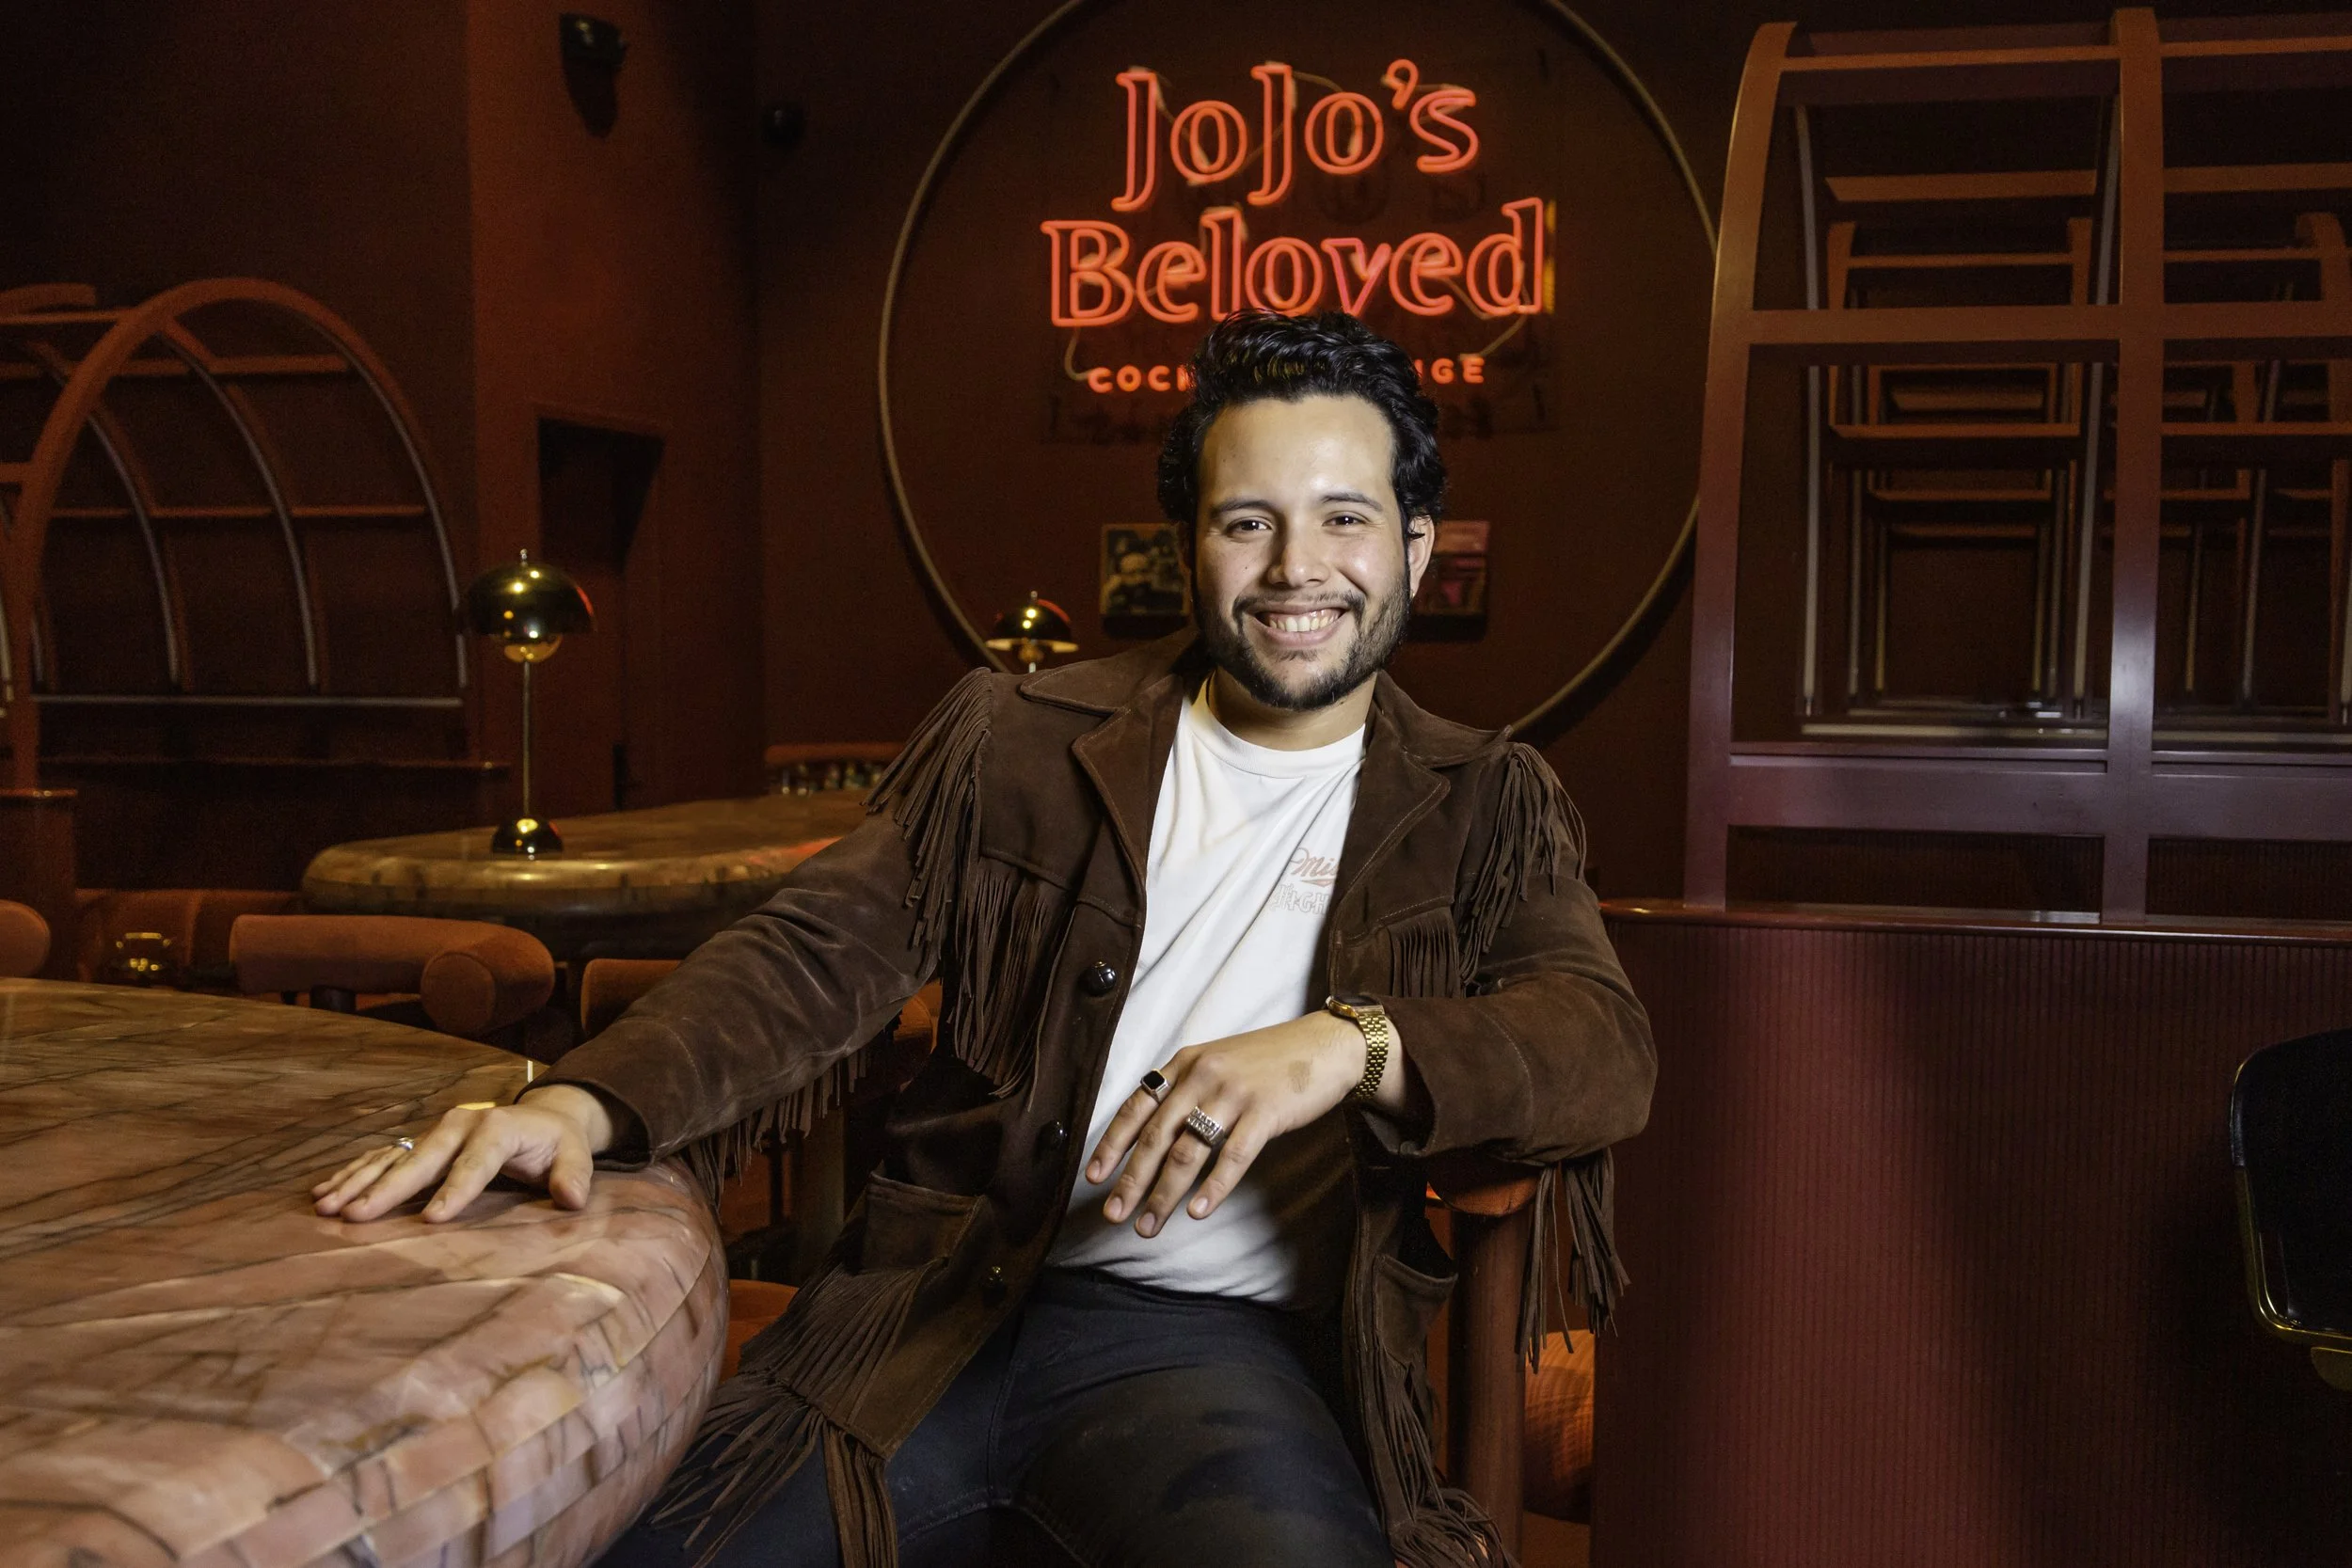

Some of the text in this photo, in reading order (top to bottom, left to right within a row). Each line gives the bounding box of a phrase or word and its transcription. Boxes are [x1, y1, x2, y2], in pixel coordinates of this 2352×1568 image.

[1111, 59, 1480, 212] JoJo's
[1041, 197, 1545, 326] Beloved
[1414, 355, 1485, 385] GE
